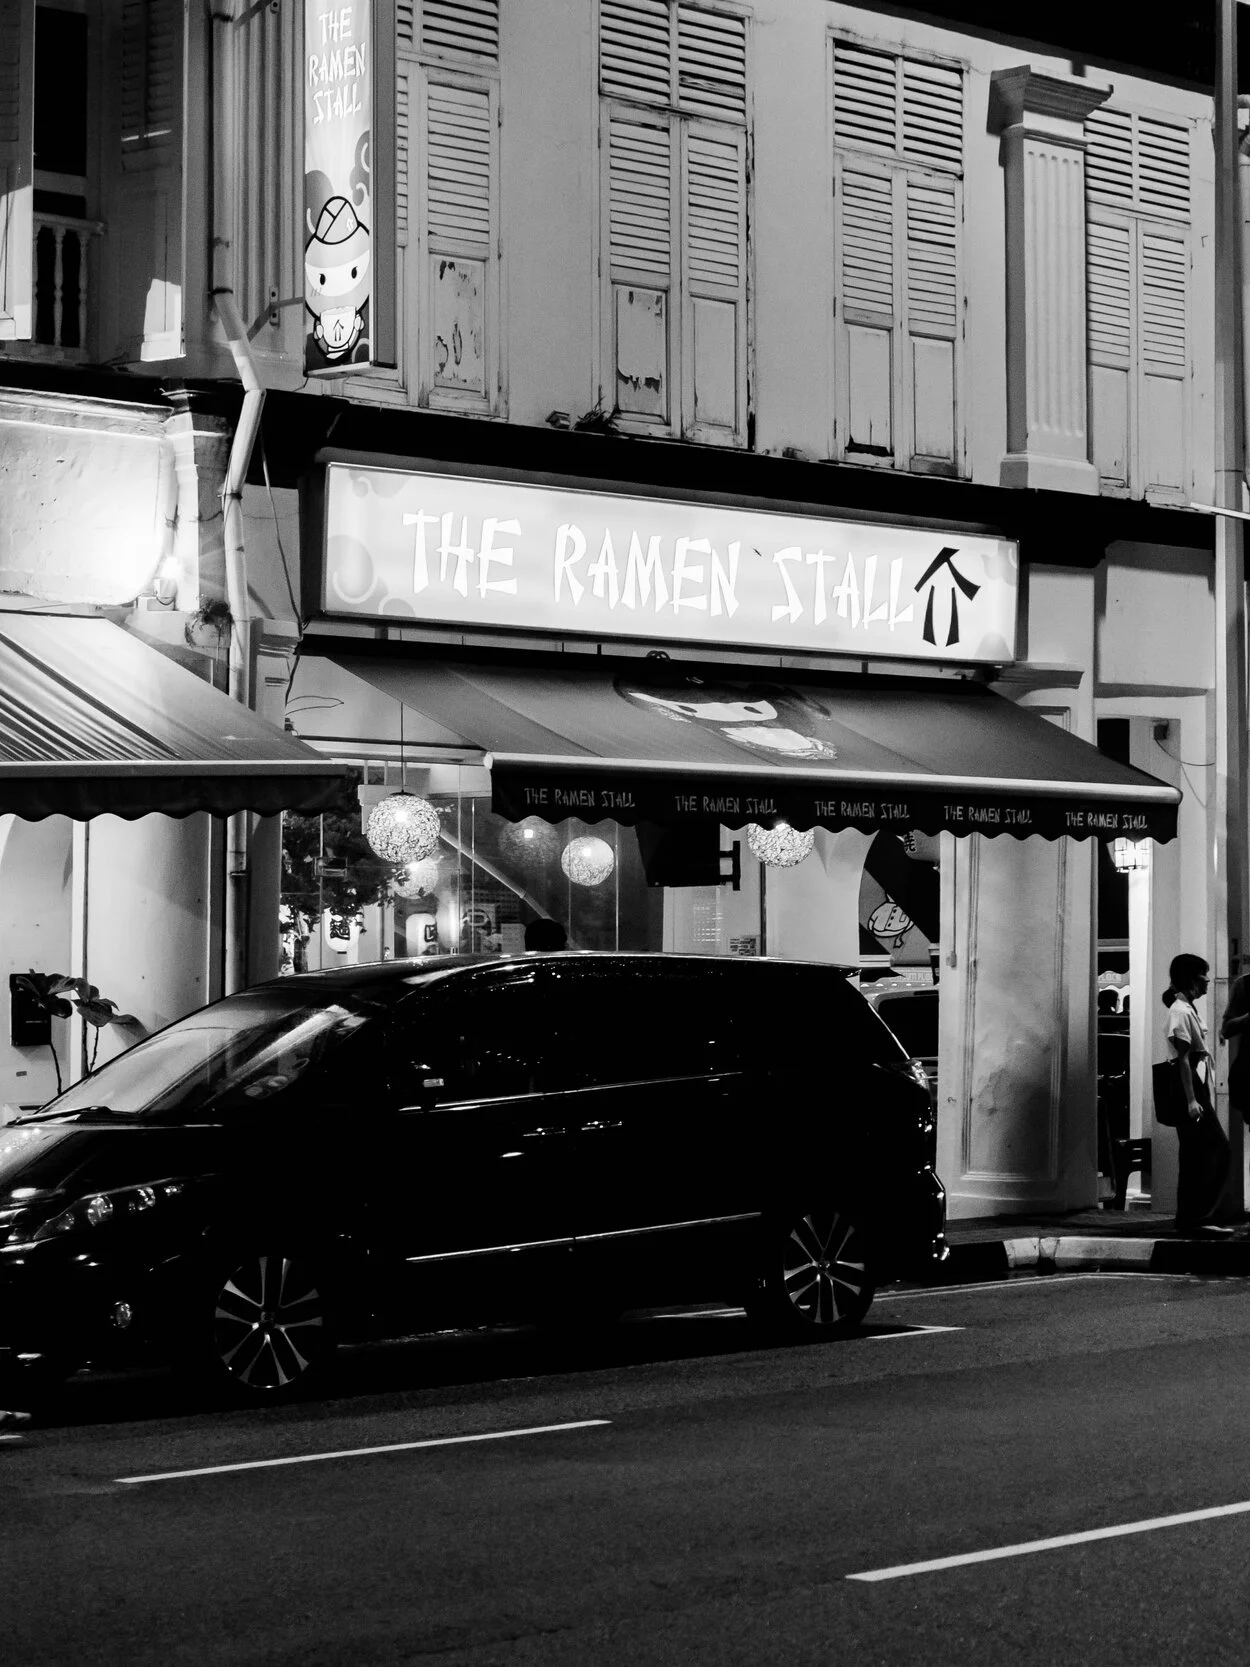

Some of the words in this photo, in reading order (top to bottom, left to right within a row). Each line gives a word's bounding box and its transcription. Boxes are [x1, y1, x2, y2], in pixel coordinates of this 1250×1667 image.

[318, 7, 353, 44] THE
[309, 42, 367, 87] RAMEN
[312, 82, 363, 124] STALL
[402, 508, 522, 598] THE
[552, 523, 741, 618] RAMEN
[771, 546, 914, 632] STALL
[524, 788, 548, 804] THE
[555, 789, 595, 807] RAMEN
[601, 791, 636, 808] STALL
[674, 796, 697, 812] THE
[703, 796, 740, 814] RAMEN
[746, 798, 777, 814] STALL
[814, 801, 836, 817] THE
[840, 801, 875, 818] RAMEN
[880, 803, 910, 819] STALL
[944, 805, 963, 820] THE
[968, 806, 1000, 823] RAMEN
[1004, 808, 1032, 824] STALL
[1065, 812, 1084, 826] THE
[1087, 812, 1118, 828] RAMEN
[1122, 814, 1147, 829] STALL
